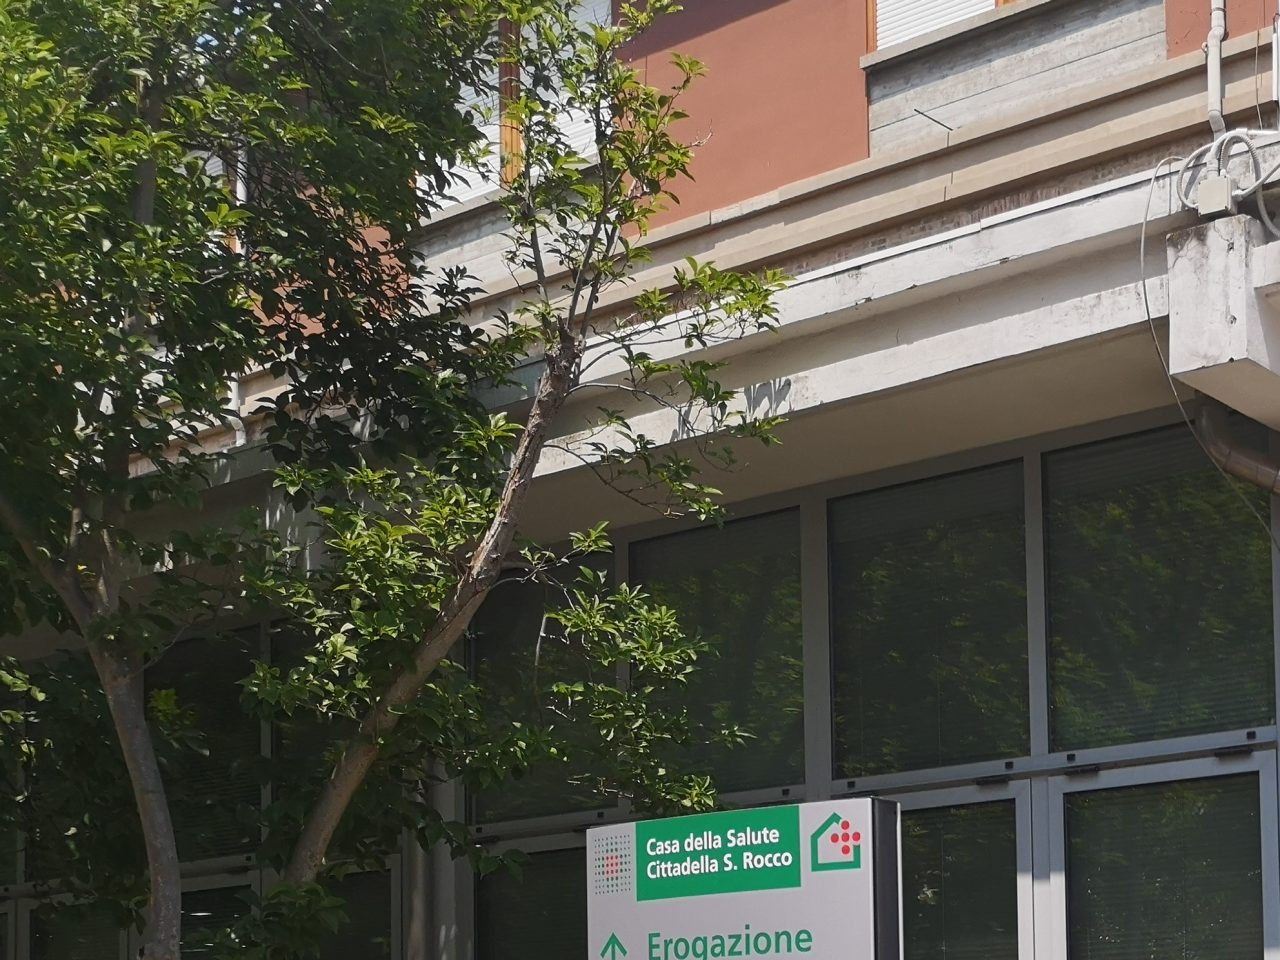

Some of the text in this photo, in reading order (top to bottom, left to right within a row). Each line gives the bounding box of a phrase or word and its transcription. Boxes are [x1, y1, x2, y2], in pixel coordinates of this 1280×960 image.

[646, 826, 780, 856] Casa della Salute
[646, 851, 793, 880] Cittadella S. Rocco
